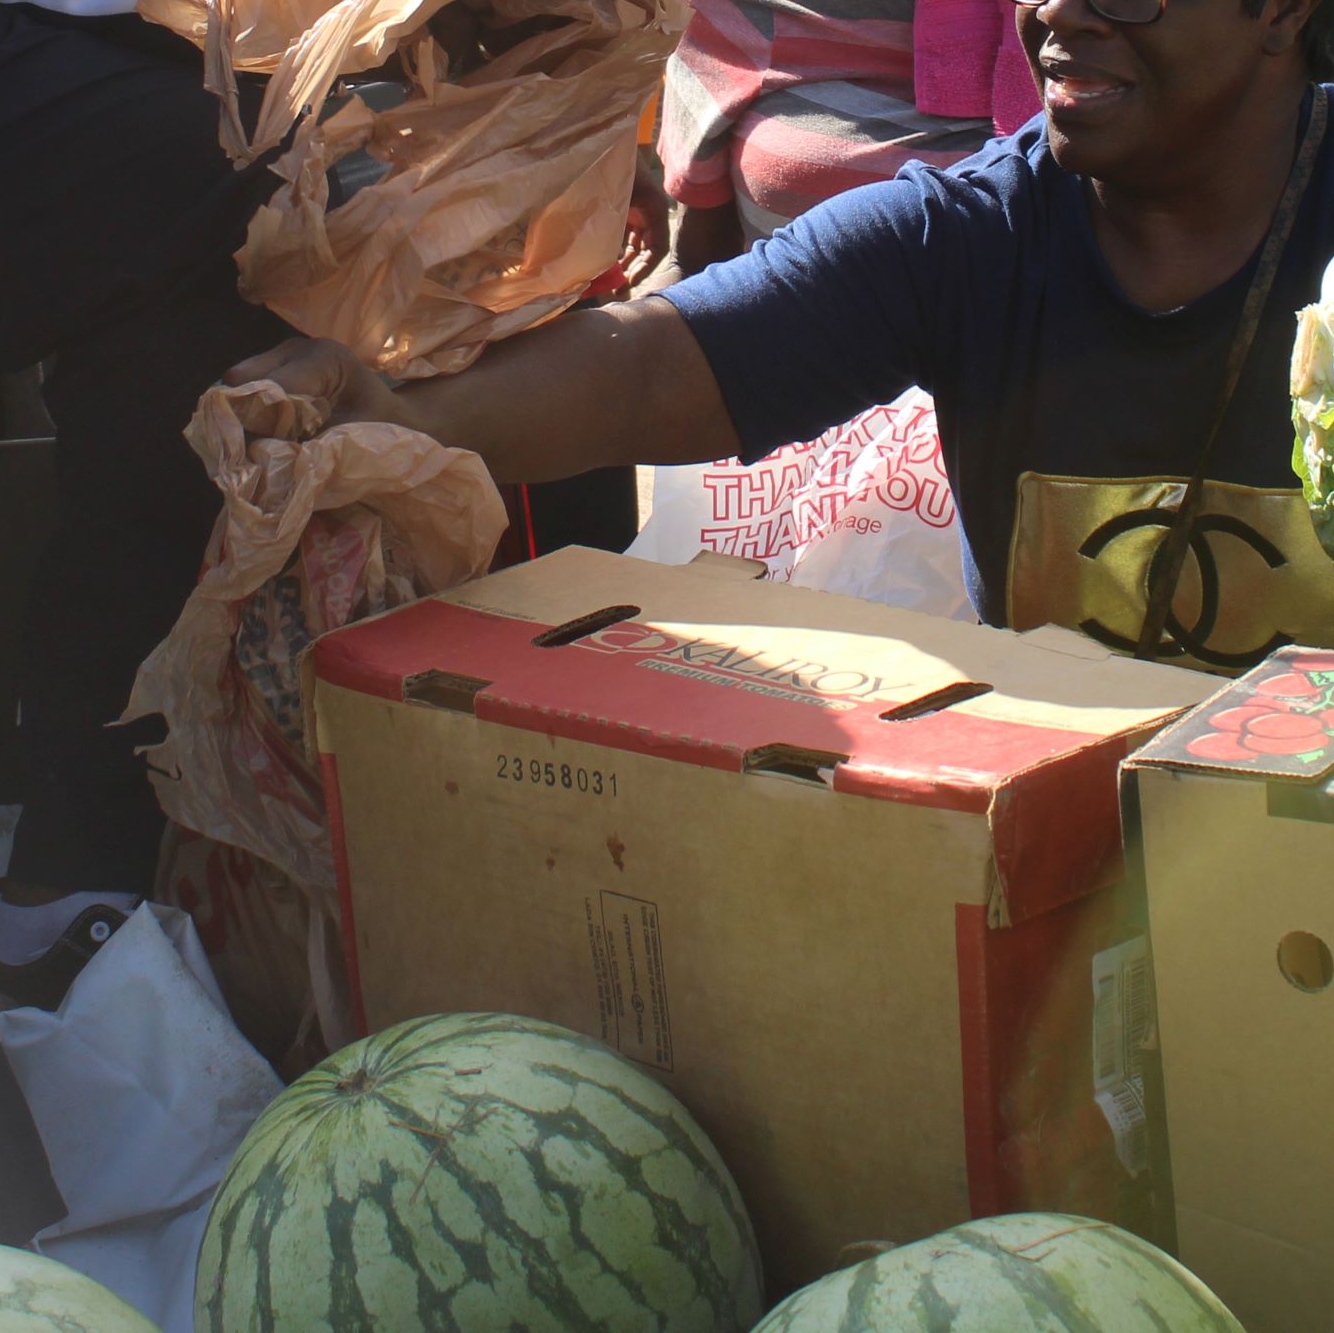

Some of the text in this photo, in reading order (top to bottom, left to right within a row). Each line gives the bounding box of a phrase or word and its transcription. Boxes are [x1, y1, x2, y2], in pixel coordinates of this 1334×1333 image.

[636, 659, 857, 711] PREMIUM TOMATOES
[664, 637, 915, 702] KALIROY
[496, 753, 618, 797] 23958031
